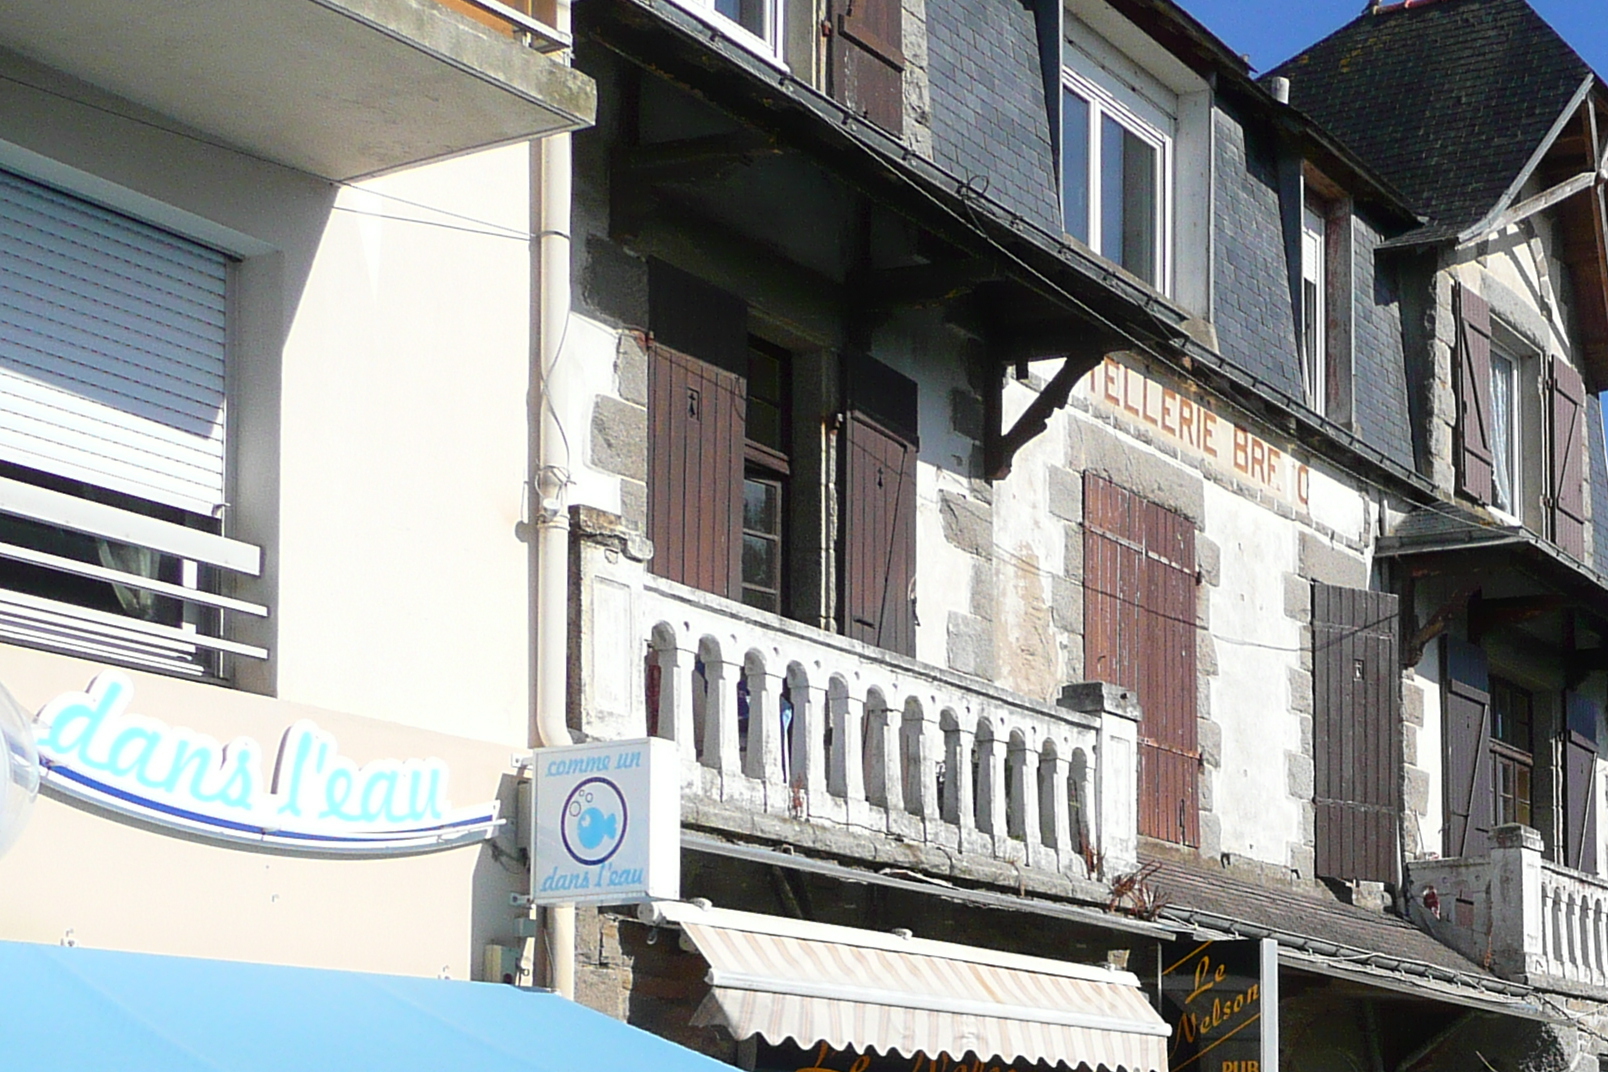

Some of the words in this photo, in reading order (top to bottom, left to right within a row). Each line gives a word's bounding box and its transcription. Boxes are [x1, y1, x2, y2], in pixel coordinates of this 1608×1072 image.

[37, 681, 252, 811] dans
[278, 729, 443, 823] l'eau
[545, 755, 610, 777] comme
[614, 752, 641, 770] un
[540, 866, 590, 892] dans
[594, 861, 644, 887] l'eau
[1185, 955, 1226, 1004] Le
[1168, 983, 1259, 1060] Nelson
